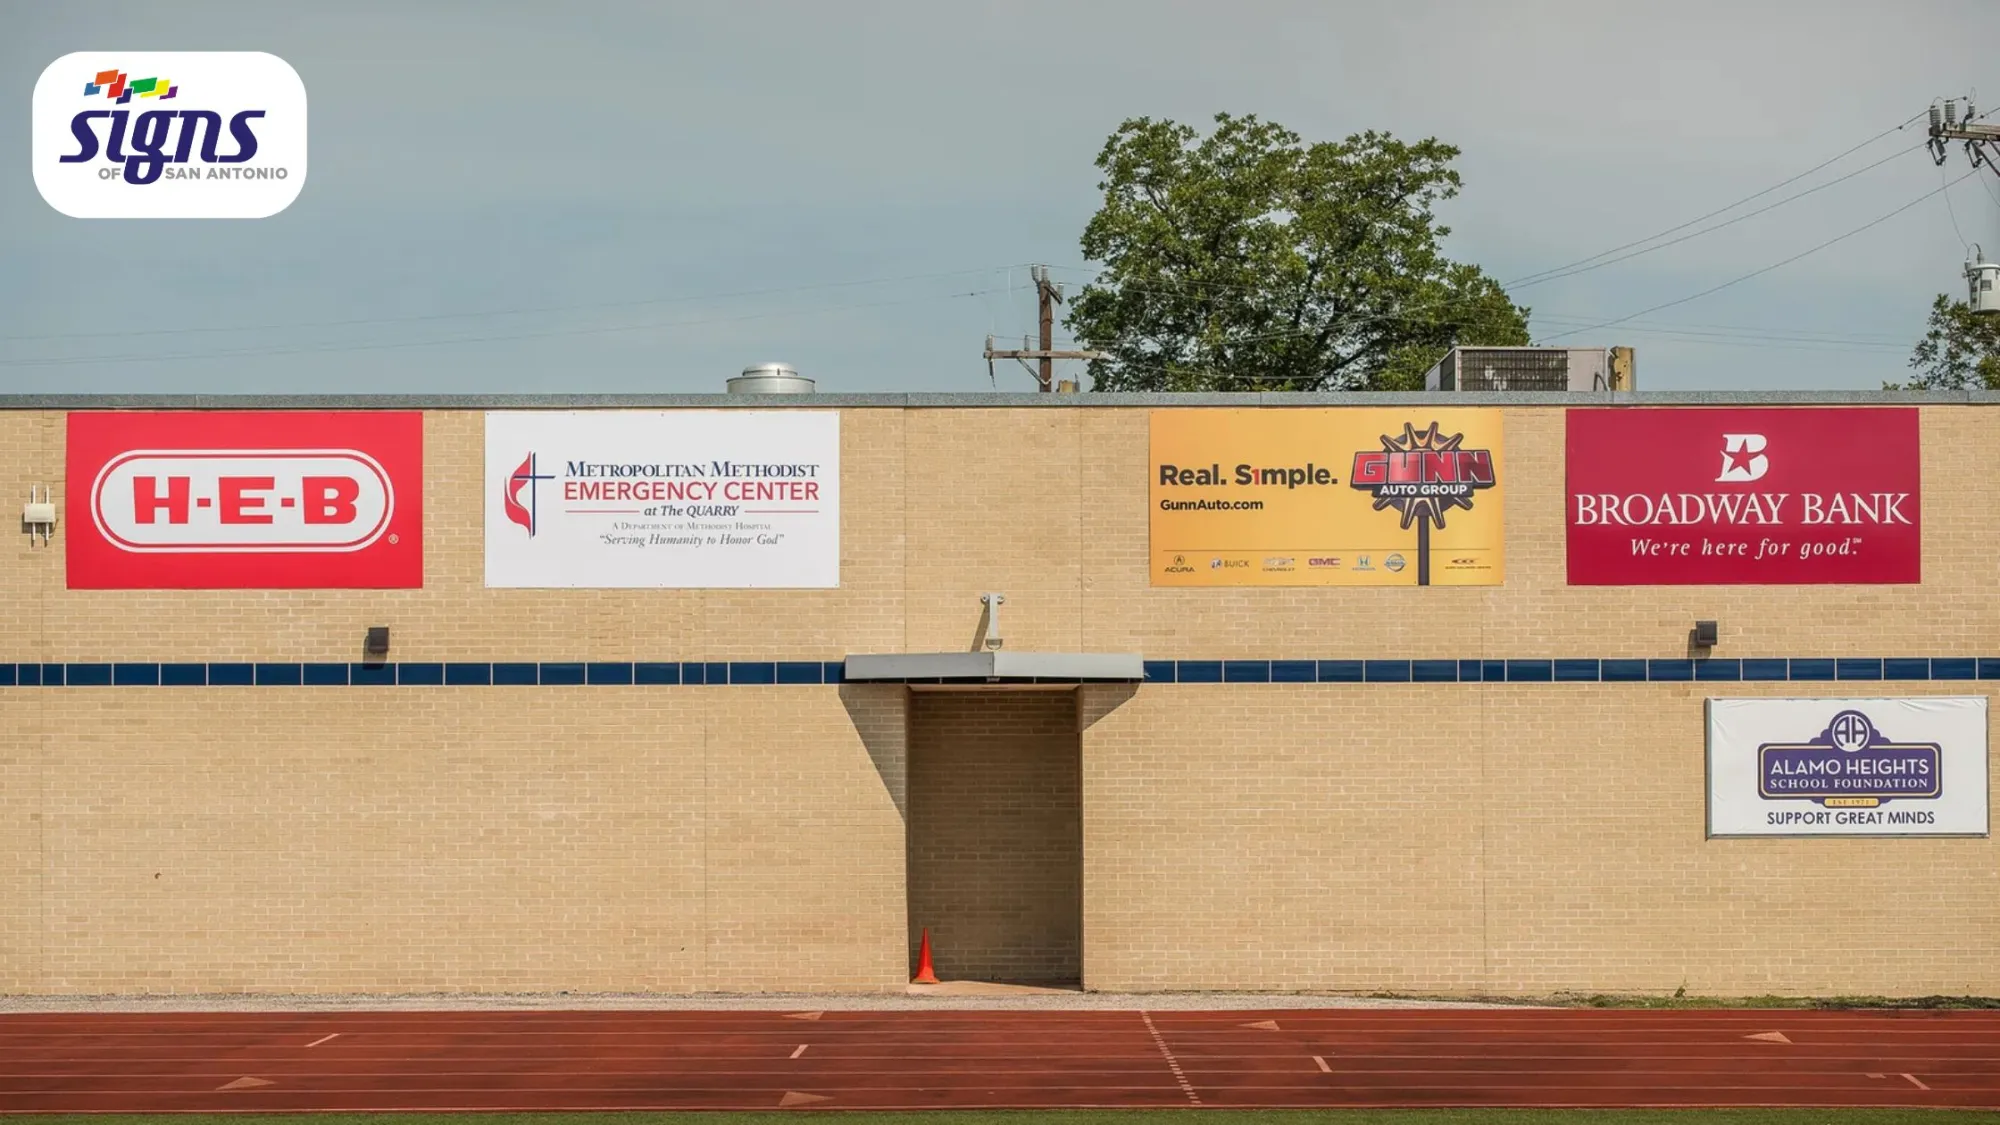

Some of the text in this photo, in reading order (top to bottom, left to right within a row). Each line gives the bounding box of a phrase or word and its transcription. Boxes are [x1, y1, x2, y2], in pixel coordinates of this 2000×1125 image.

[566, 461, 820, 477] METROPOLITAN METHODIST
[1159, 464, 1227, 486] Real.
[1351, 451, 1494, 485] GUNN
[564, 482, 819, 501] EMERGENCY CENTER
[1380, 484, 1468, 496] AUTO GROUP
[133, 476, 360, 524] H-E-B
[1160, 499, 1264, 511] GunnAuto.com
[644, 506, 739, 518] at The QUARRY
[1574, 493, 1913, 525] BROADWAY BANK
[649, 534, 703, 548] Humanity
[706, 535, 716, 545] to
[720, 534, 753, 545] Honor
[1702, 539, 1747, 556] here
[1755, 538, 1790, 560] for
[1223, 559, 1250, 569] BUICK
[1308, 557, 1341, 567] GMC
[1771, 759, 1929, 775] ALAMO HEIGHTS
[1770, 779, 1928, 789] SCHOOL FOUNDATION
[1767, 811, 1935, 825] SUPPORT GREAT MINDS
